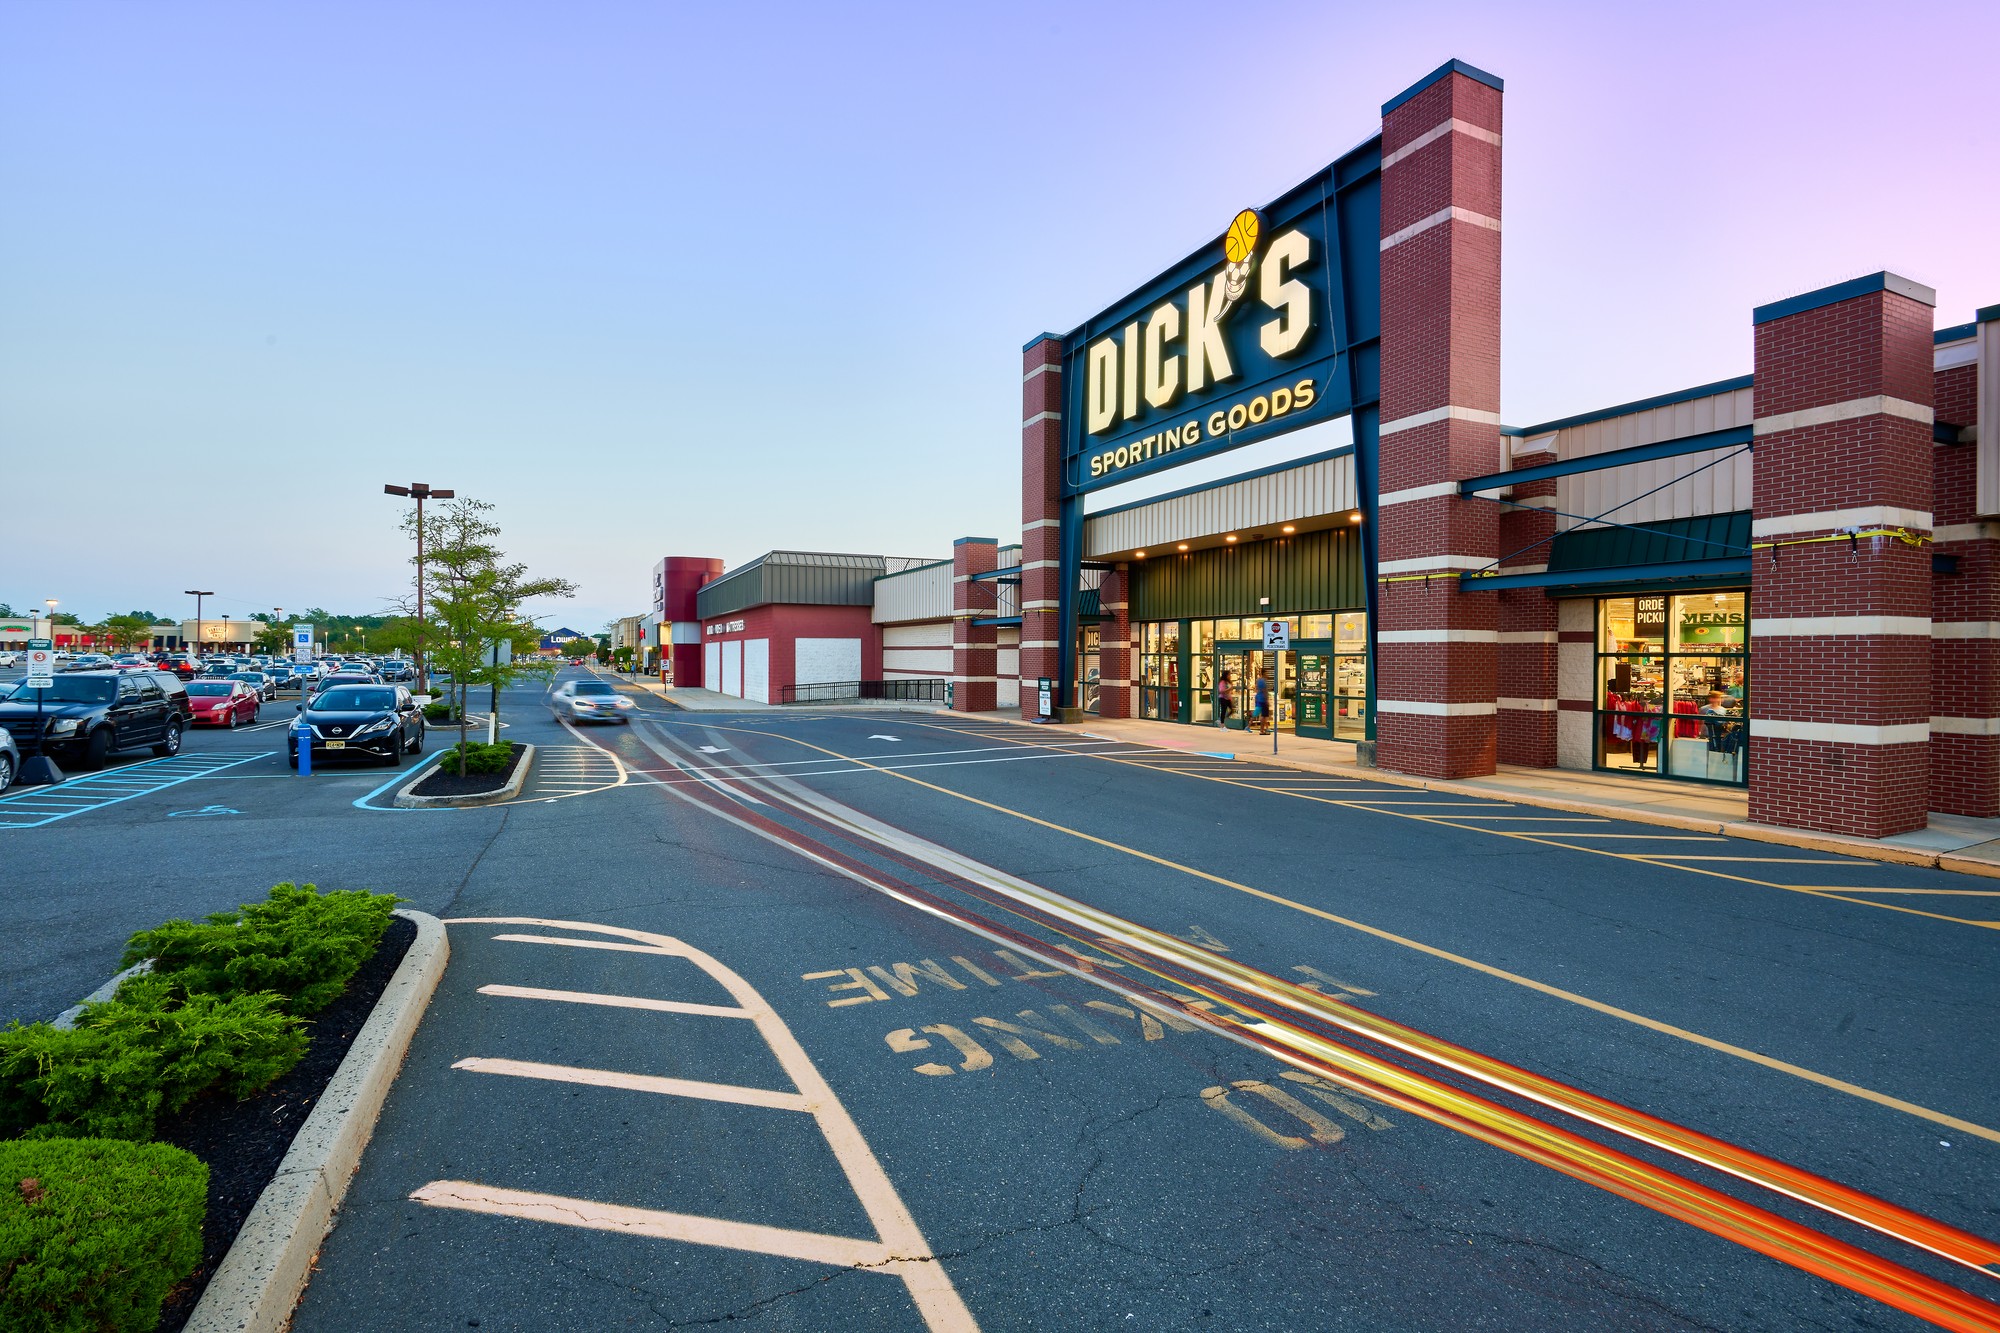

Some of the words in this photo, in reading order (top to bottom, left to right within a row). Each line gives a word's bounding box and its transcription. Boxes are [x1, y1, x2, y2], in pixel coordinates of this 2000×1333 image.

[1087, 209, 1312, 435] DICK'S
[1090, 420, 1201, 477] SPORTING
[1207, 378, 1316, 437] GOODS
[1681, 612, 1743, 624] MENS
